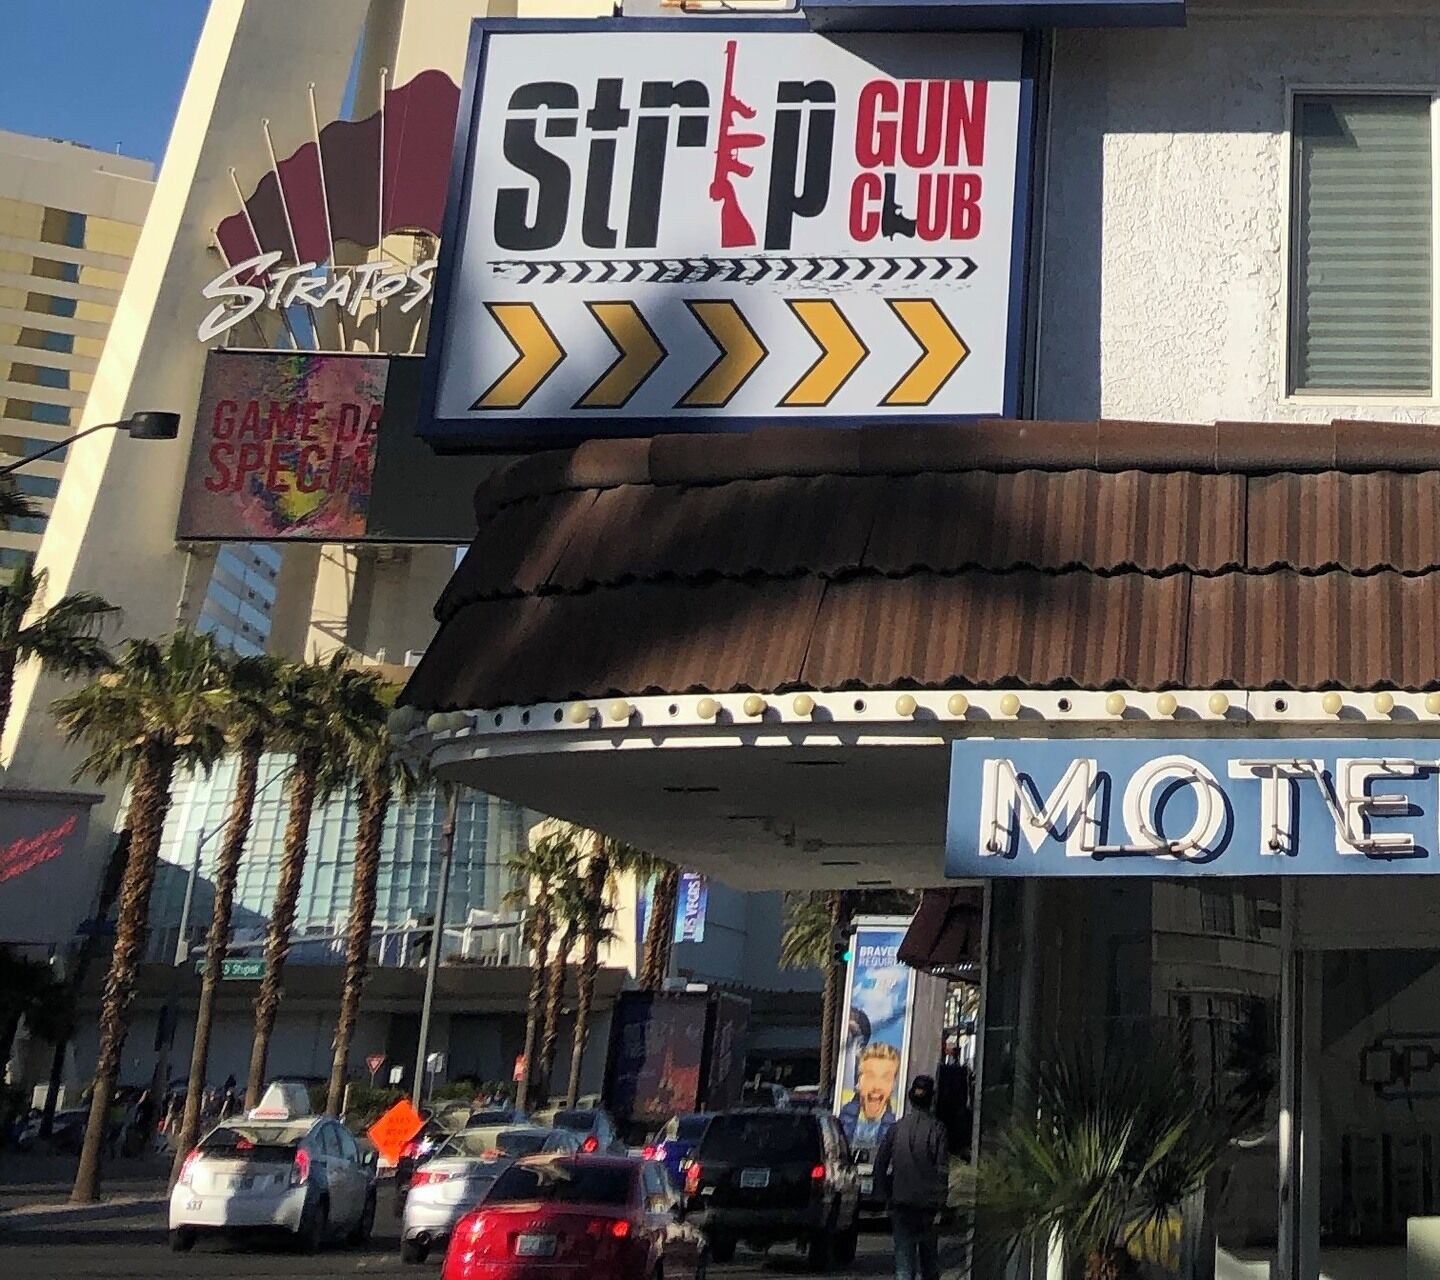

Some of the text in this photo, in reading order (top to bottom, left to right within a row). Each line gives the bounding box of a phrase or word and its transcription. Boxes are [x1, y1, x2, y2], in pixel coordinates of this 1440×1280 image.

[855, 79, 988, 168] GUN
[848, 172, 982, 242] CLUB
[213, 400, 324, 441] GAME
